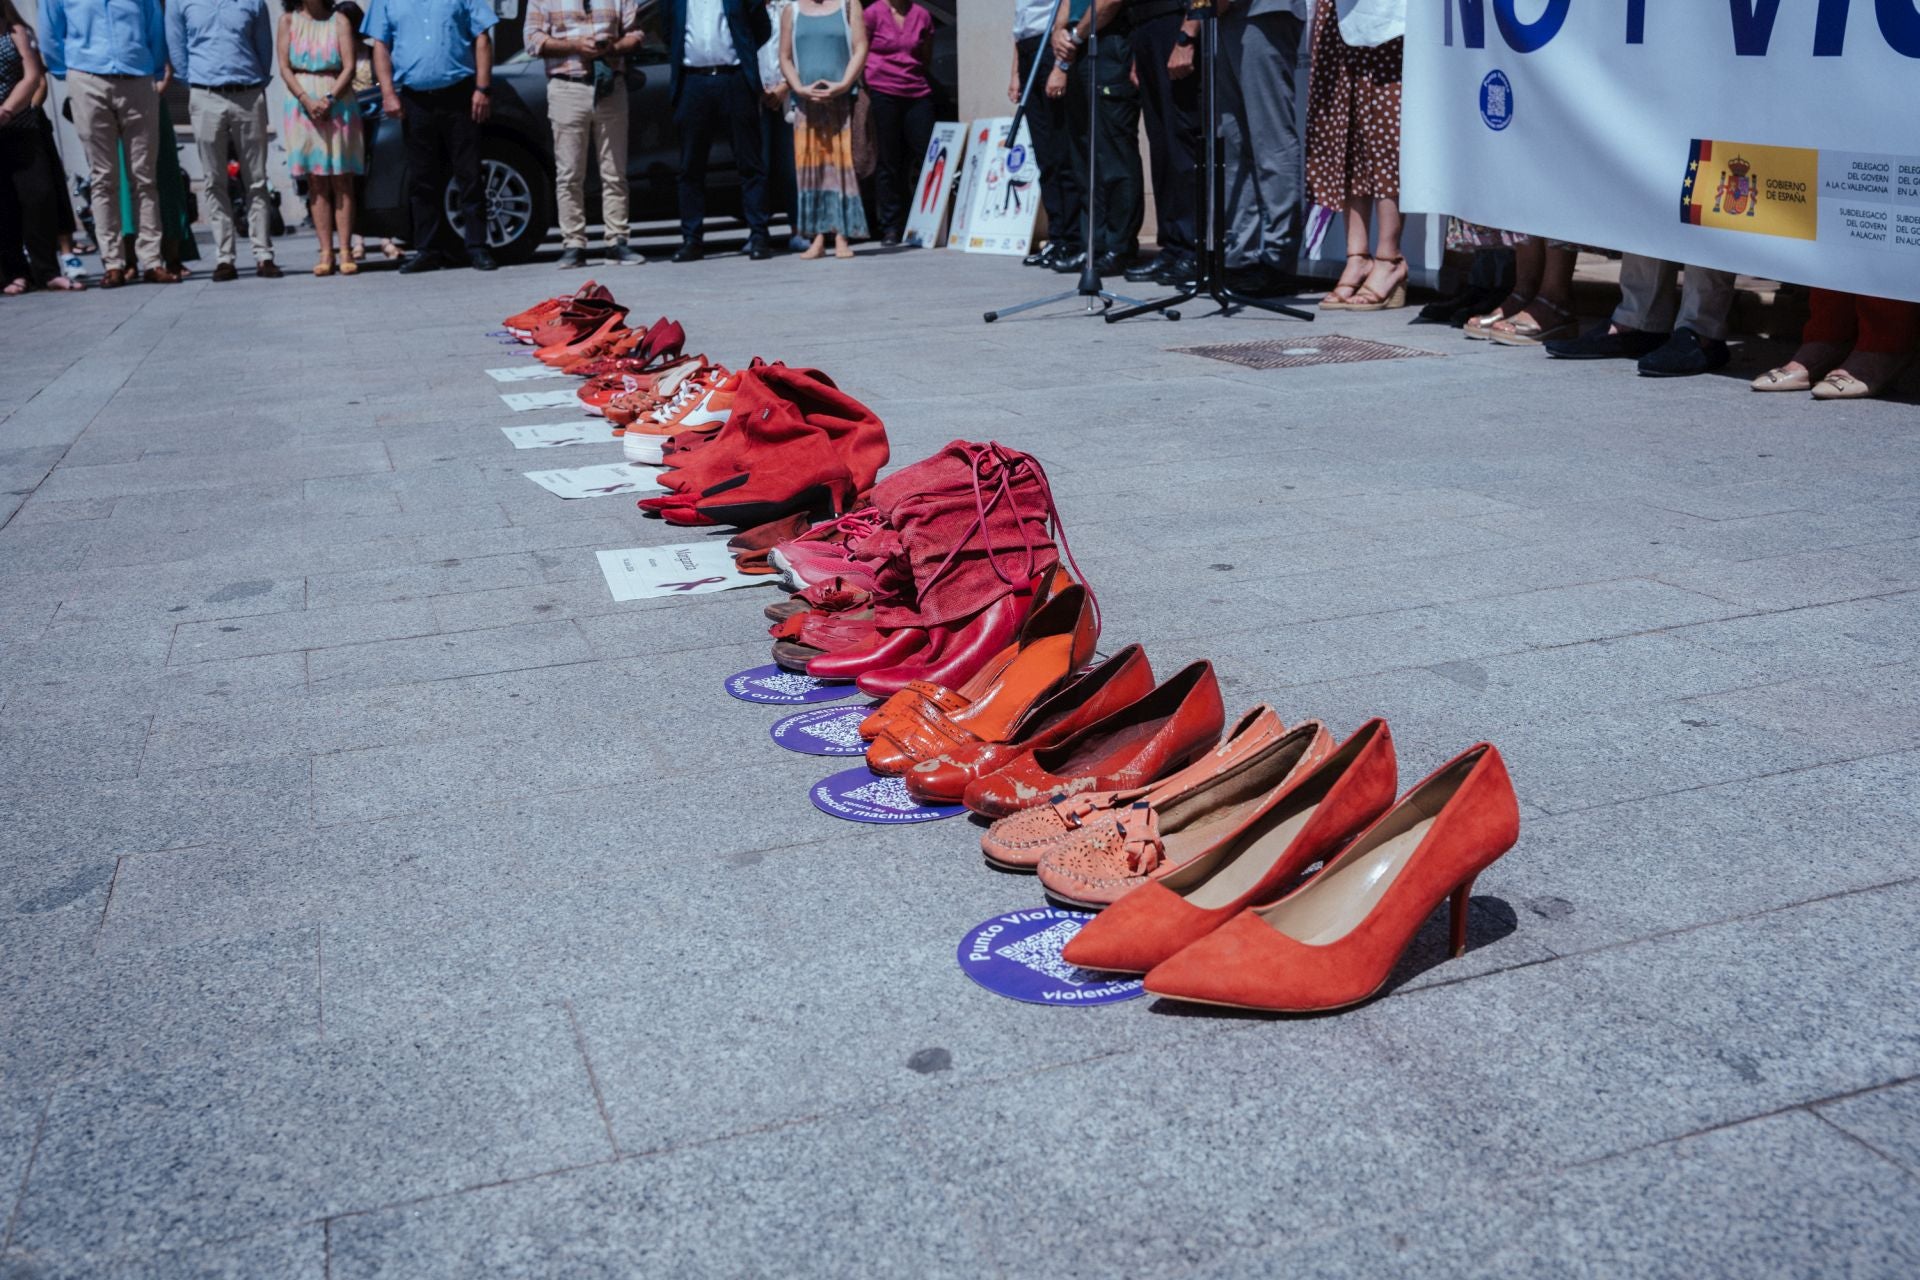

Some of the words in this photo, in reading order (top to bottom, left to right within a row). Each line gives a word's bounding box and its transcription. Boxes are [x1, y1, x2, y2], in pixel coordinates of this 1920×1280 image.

[1852, 161, 1890, 172] DELEGACIÓ
[1847, 172, 1859, 181] DEL
[1861, 173, 1889, 183] GOVERN
[1898, 176, 1911, 185] DEL
[1766, 178, 1806, 192] GOBIERNO
[1832, 181, 1840, 189] LA
[1766, 191, 1777, 200] DE
[1778, 191, 1806, 203] ESPAÑA
[1898, 187, 1907, 195] EN
[1908, 188, 1918, 197] LA
[1840, 208, 1887, 220] SUBDELEGACIÓ
[1847, 219, 1858, 228] DEL
[1860, 220, 1887, 231] GOVERN
[1896, 225, 1908, 234] DEL
[1856, 231, 1886, 241] ALACANT
[1896, 236, 1905, 244] EN
[752, 693, 804, 701] Punto
[853, 810, 940, 820] machistas
[969, 924, 1005, 961] Punto
[1001, 909, 1097, 925] Violeta
[1042, 979, 1144, 1000] violencias
